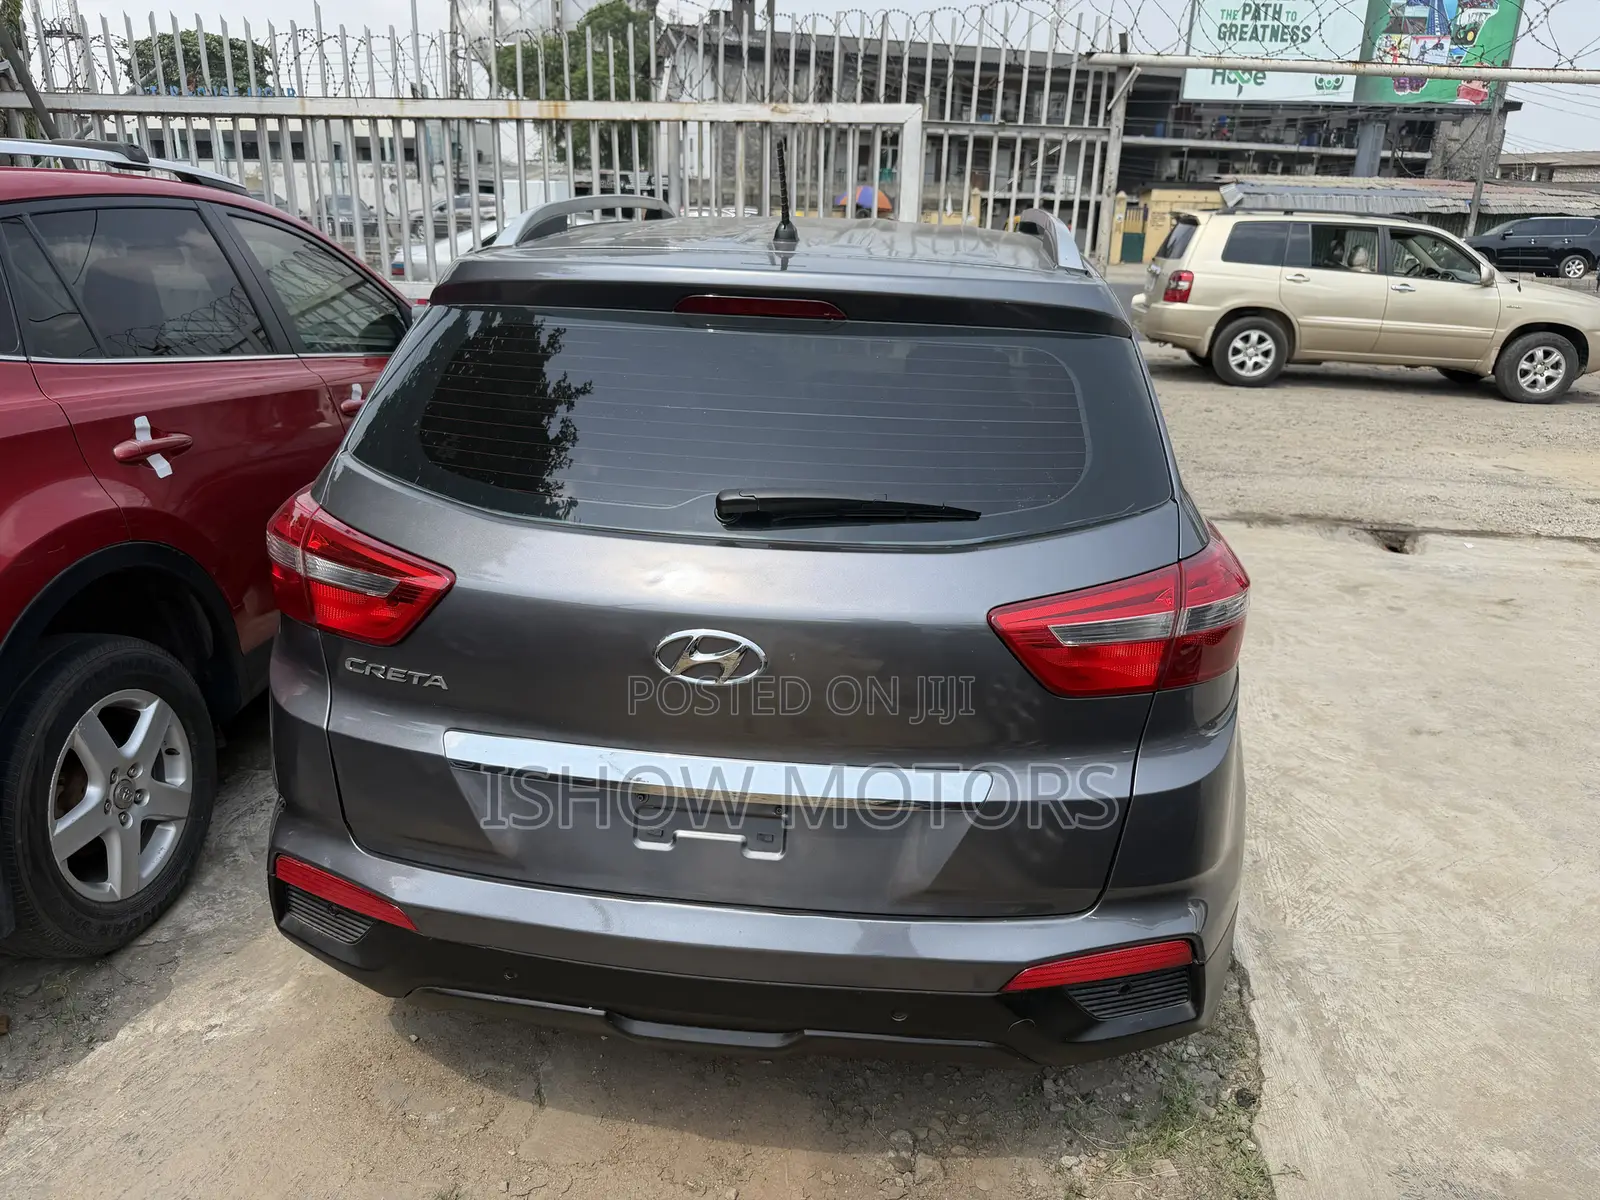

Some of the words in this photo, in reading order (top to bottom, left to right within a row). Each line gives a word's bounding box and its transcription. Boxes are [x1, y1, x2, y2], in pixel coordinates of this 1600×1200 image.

[1220, 9, 1238, 21] THE
[1241, 3, 1283, 21] PATH
[1285, 11, 1298, 22] TO
[1217, 23, 1312, 43] GREATNESS
[344, 657, 448, 690] CRETA
